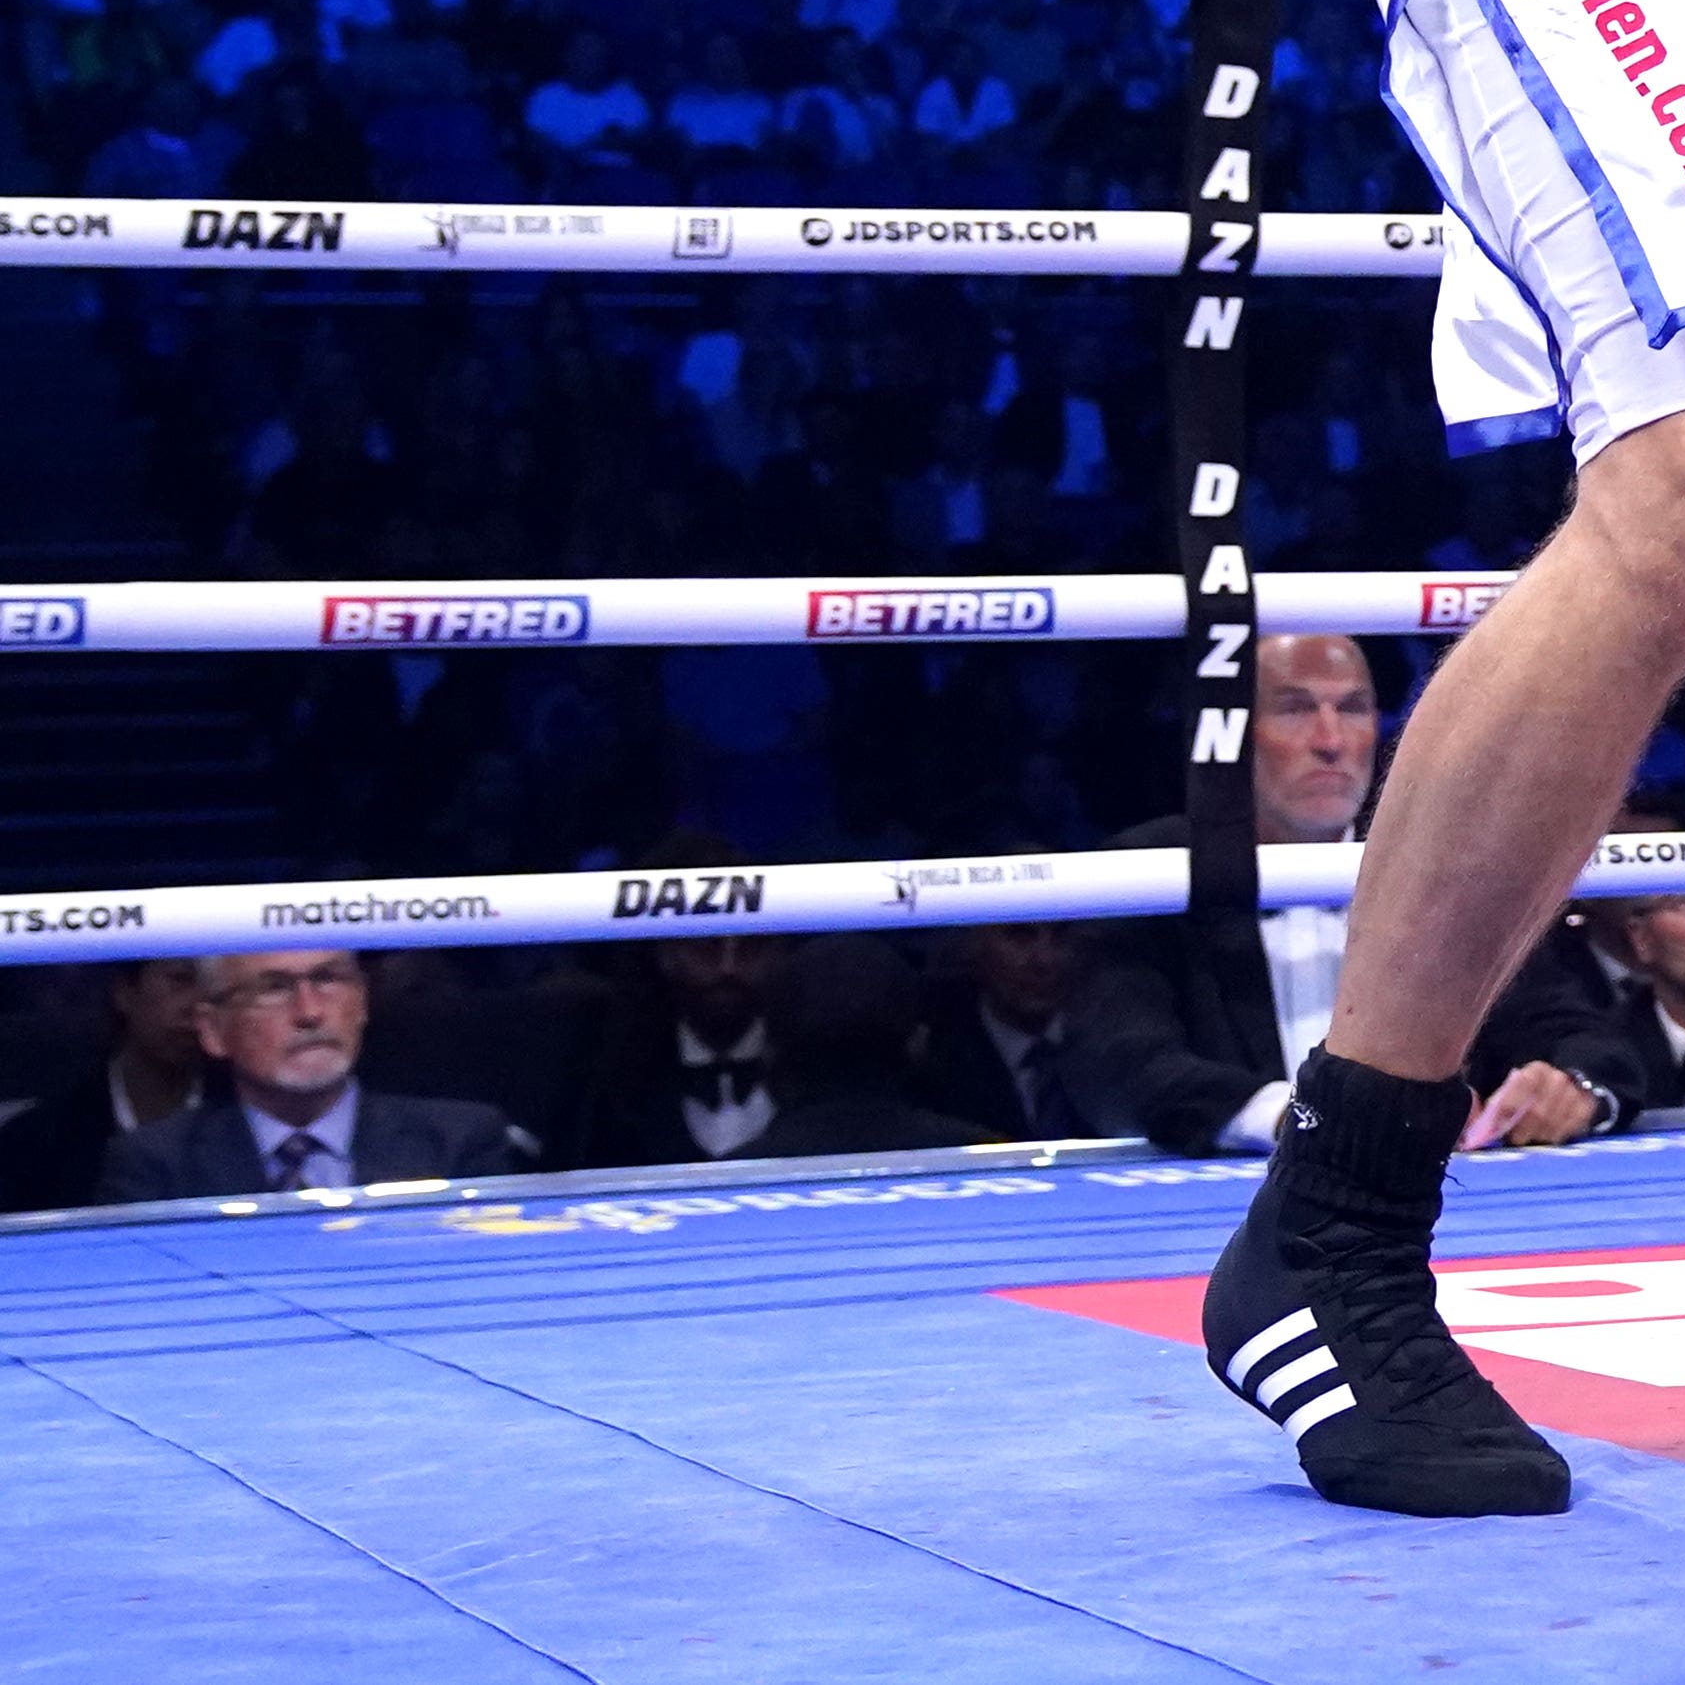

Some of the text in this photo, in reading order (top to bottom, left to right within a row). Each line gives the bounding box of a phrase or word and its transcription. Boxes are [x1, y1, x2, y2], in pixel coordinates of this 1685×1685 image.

[1186, 64, 1260, 349] DAZN
[182, 209, 345, 251] DAZN
[842, 220, 1097, 243] JDSPORTS.COM
[331, 598, 582, 642] BETFRED
[815, 591, 1050, 636] BETFRED
[1189, 463, 1251, 763] DAZN
[611, 874, 765, 919] DAZN
